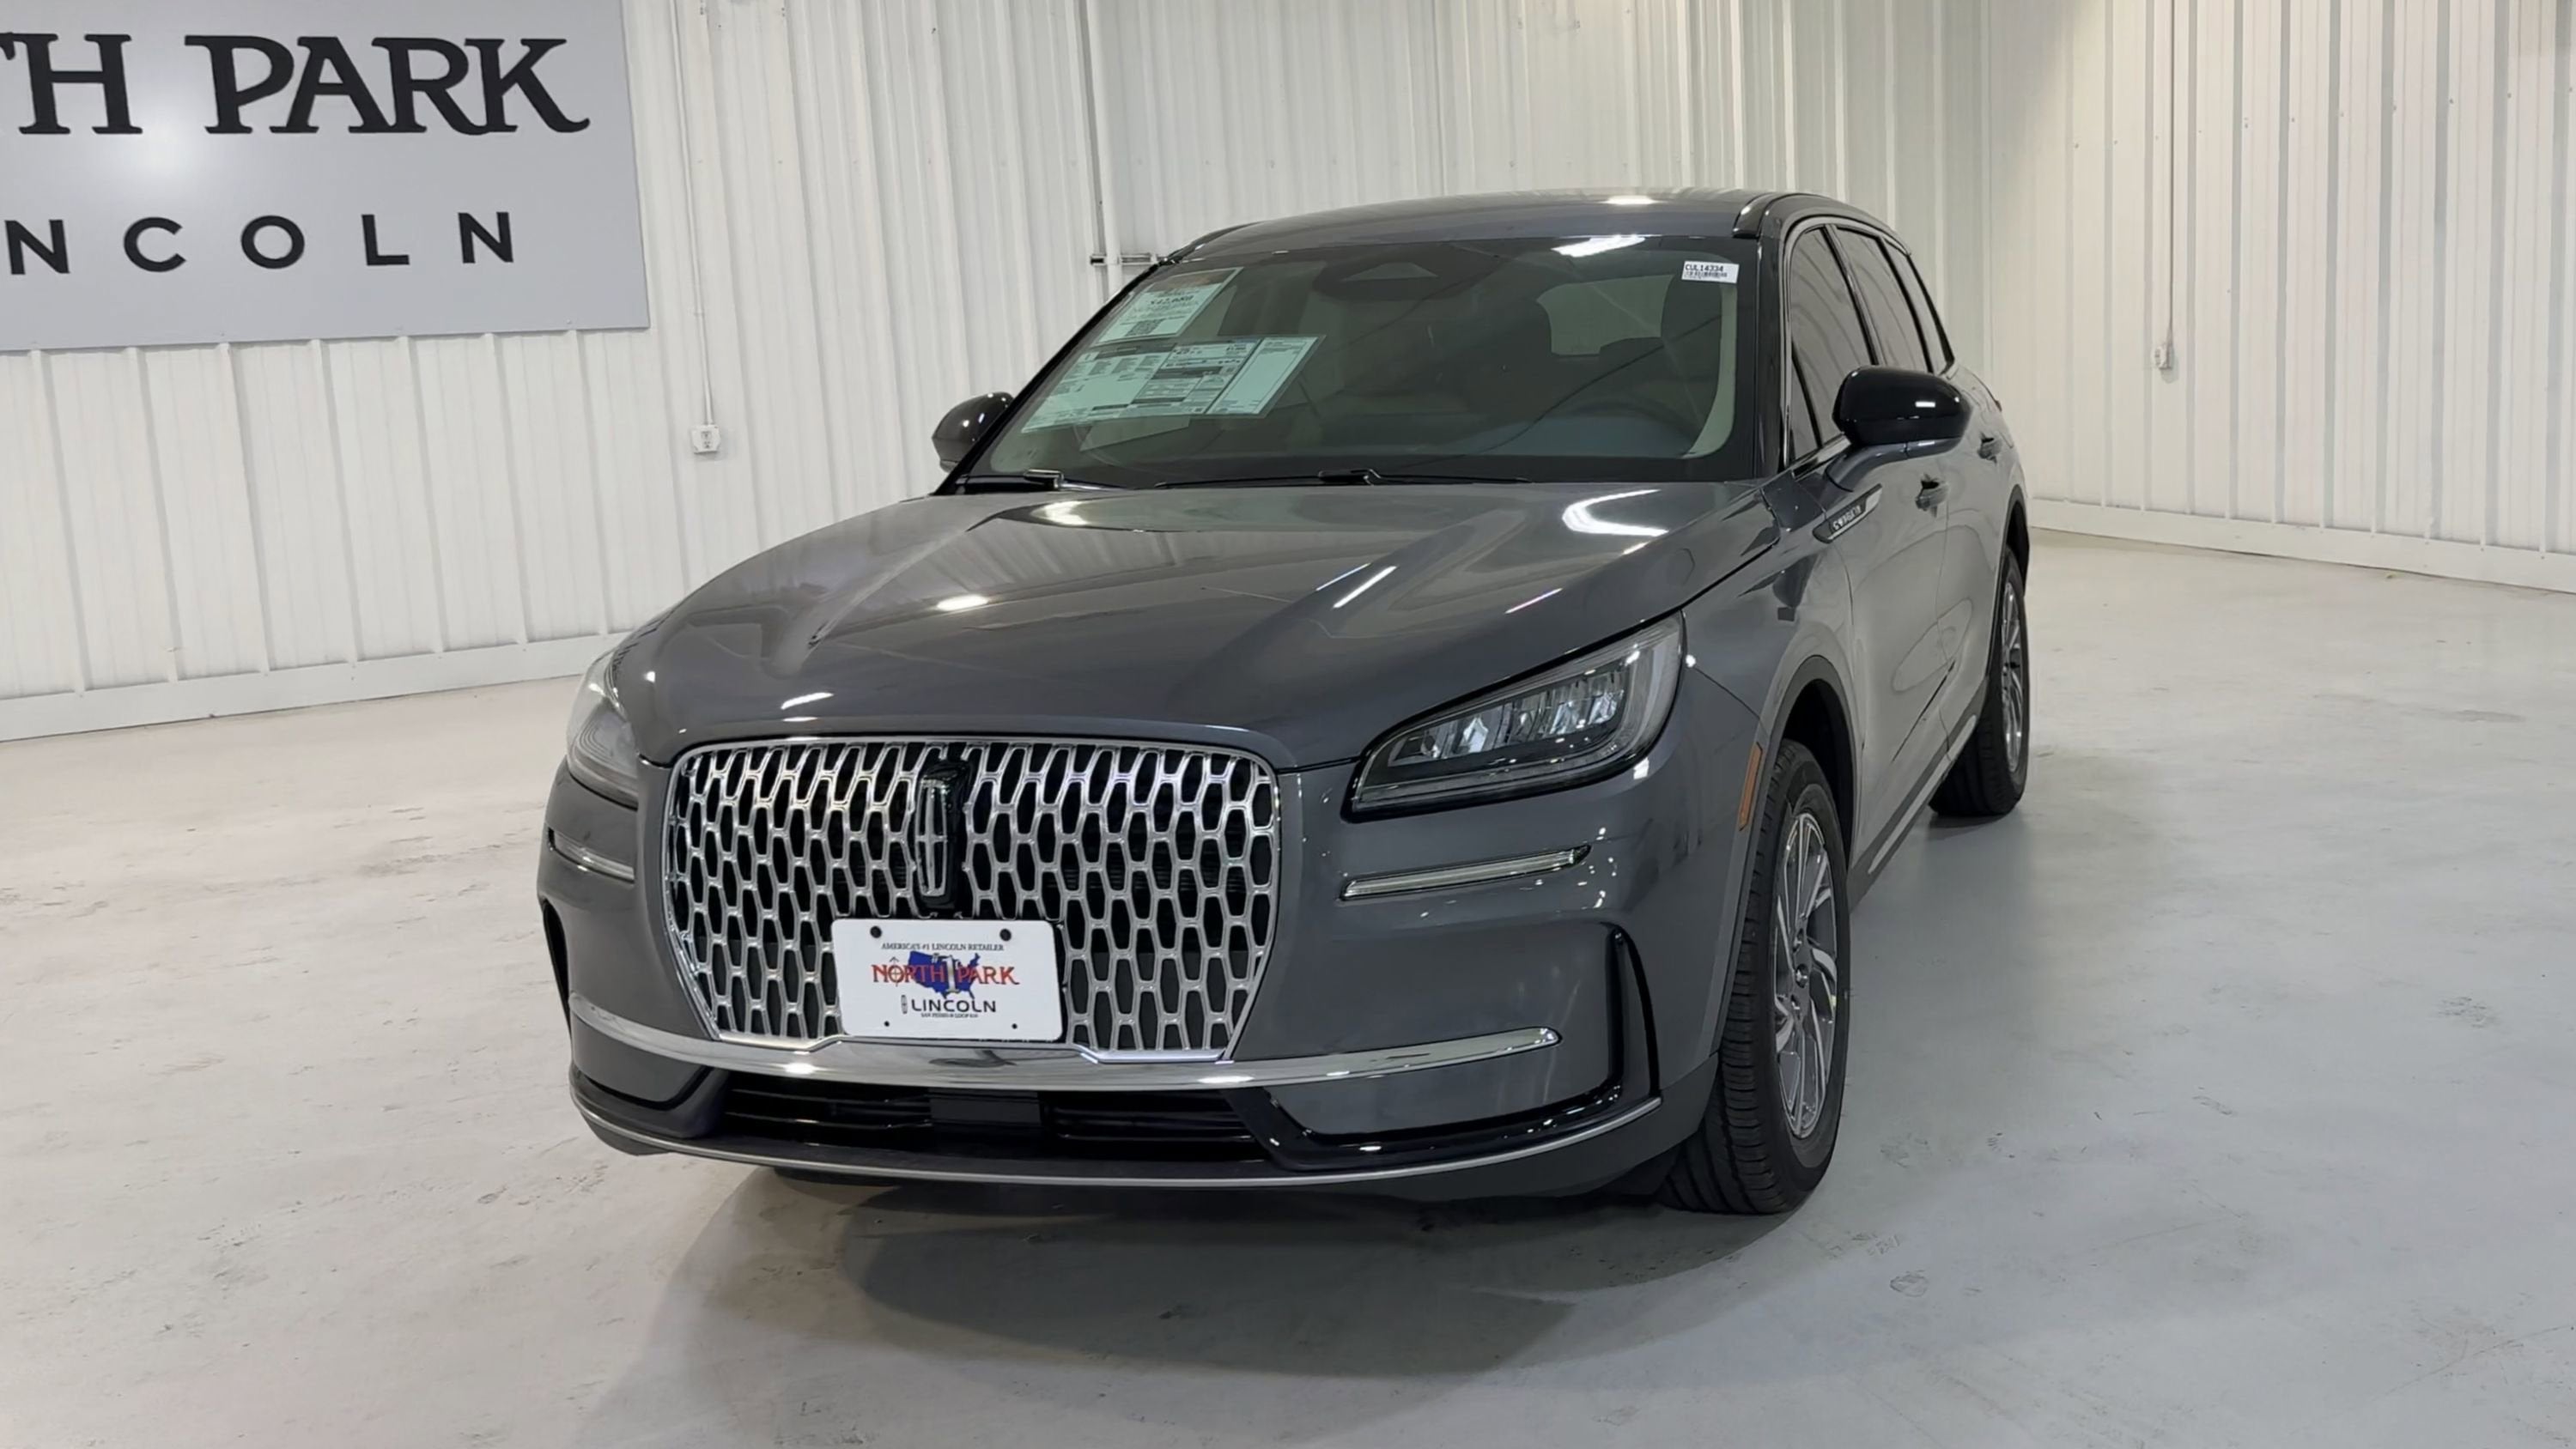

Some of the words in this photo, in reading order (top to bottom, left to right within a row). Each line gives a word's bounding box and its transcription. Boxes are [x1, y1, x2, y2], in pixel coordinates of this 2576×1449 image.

[0, 33, 143, 134] H
[185, 35, 591, 135] PARK
[3, 211, 514, 275] NCOLN
[872, 965, 944, 984] NORTH
[958, 966, 1019, 985] PARK
[911, 998, 996, 1013] LINCOLN
